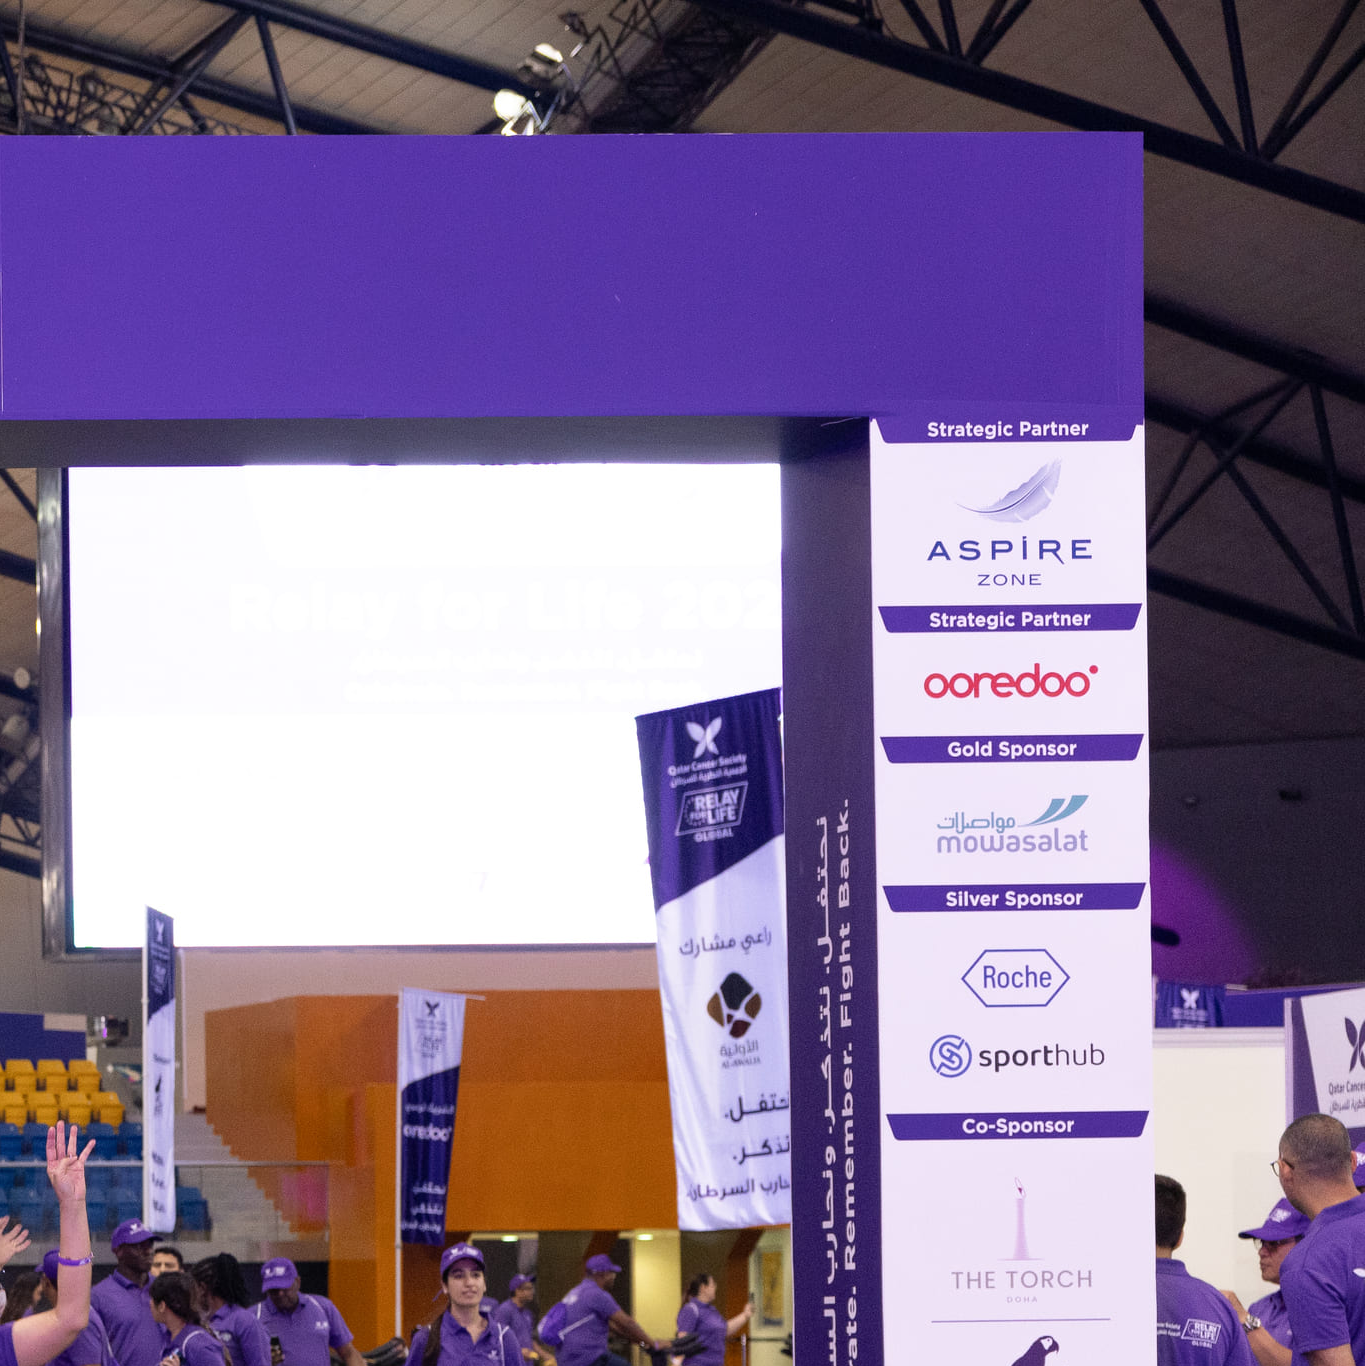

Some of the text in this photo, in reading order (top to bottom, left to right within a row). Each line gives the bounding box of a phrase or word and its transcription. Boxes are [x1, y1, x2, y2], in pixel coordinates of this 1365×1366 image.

[928, 421, 1088, 439] Strategic Partner
[978, 574, 1041, 586] ZONE
[930, 612, 1091, 630] Strategic Partner
[924, 663, 1090, 699] ooredoo
[947, 740, 1077, 759] Gold Sponsor
[693, 789, 739, 811] RELAY
[707, 807, 736, 824] LIFE
[936, 812, 1016, 834] مواصلات
[936, 829, 1089, 854] mowasalat
[837, 799, 849, 908] Back.
[946, 891, 1083, 908] Silver Sponsor
[680, 934, 736, 958] مشارك
[839, 923, 853, 1027] Fight
[984, 965, 1051, 988] Roche
[979, 1043, 1104, 1072] sporthub
[963, 1118, 1074, 1136] Co-Sponsor
[842, 1043, 855, 1270] Remember.
[951, 1270, 1091, 1290] THE TORCH
